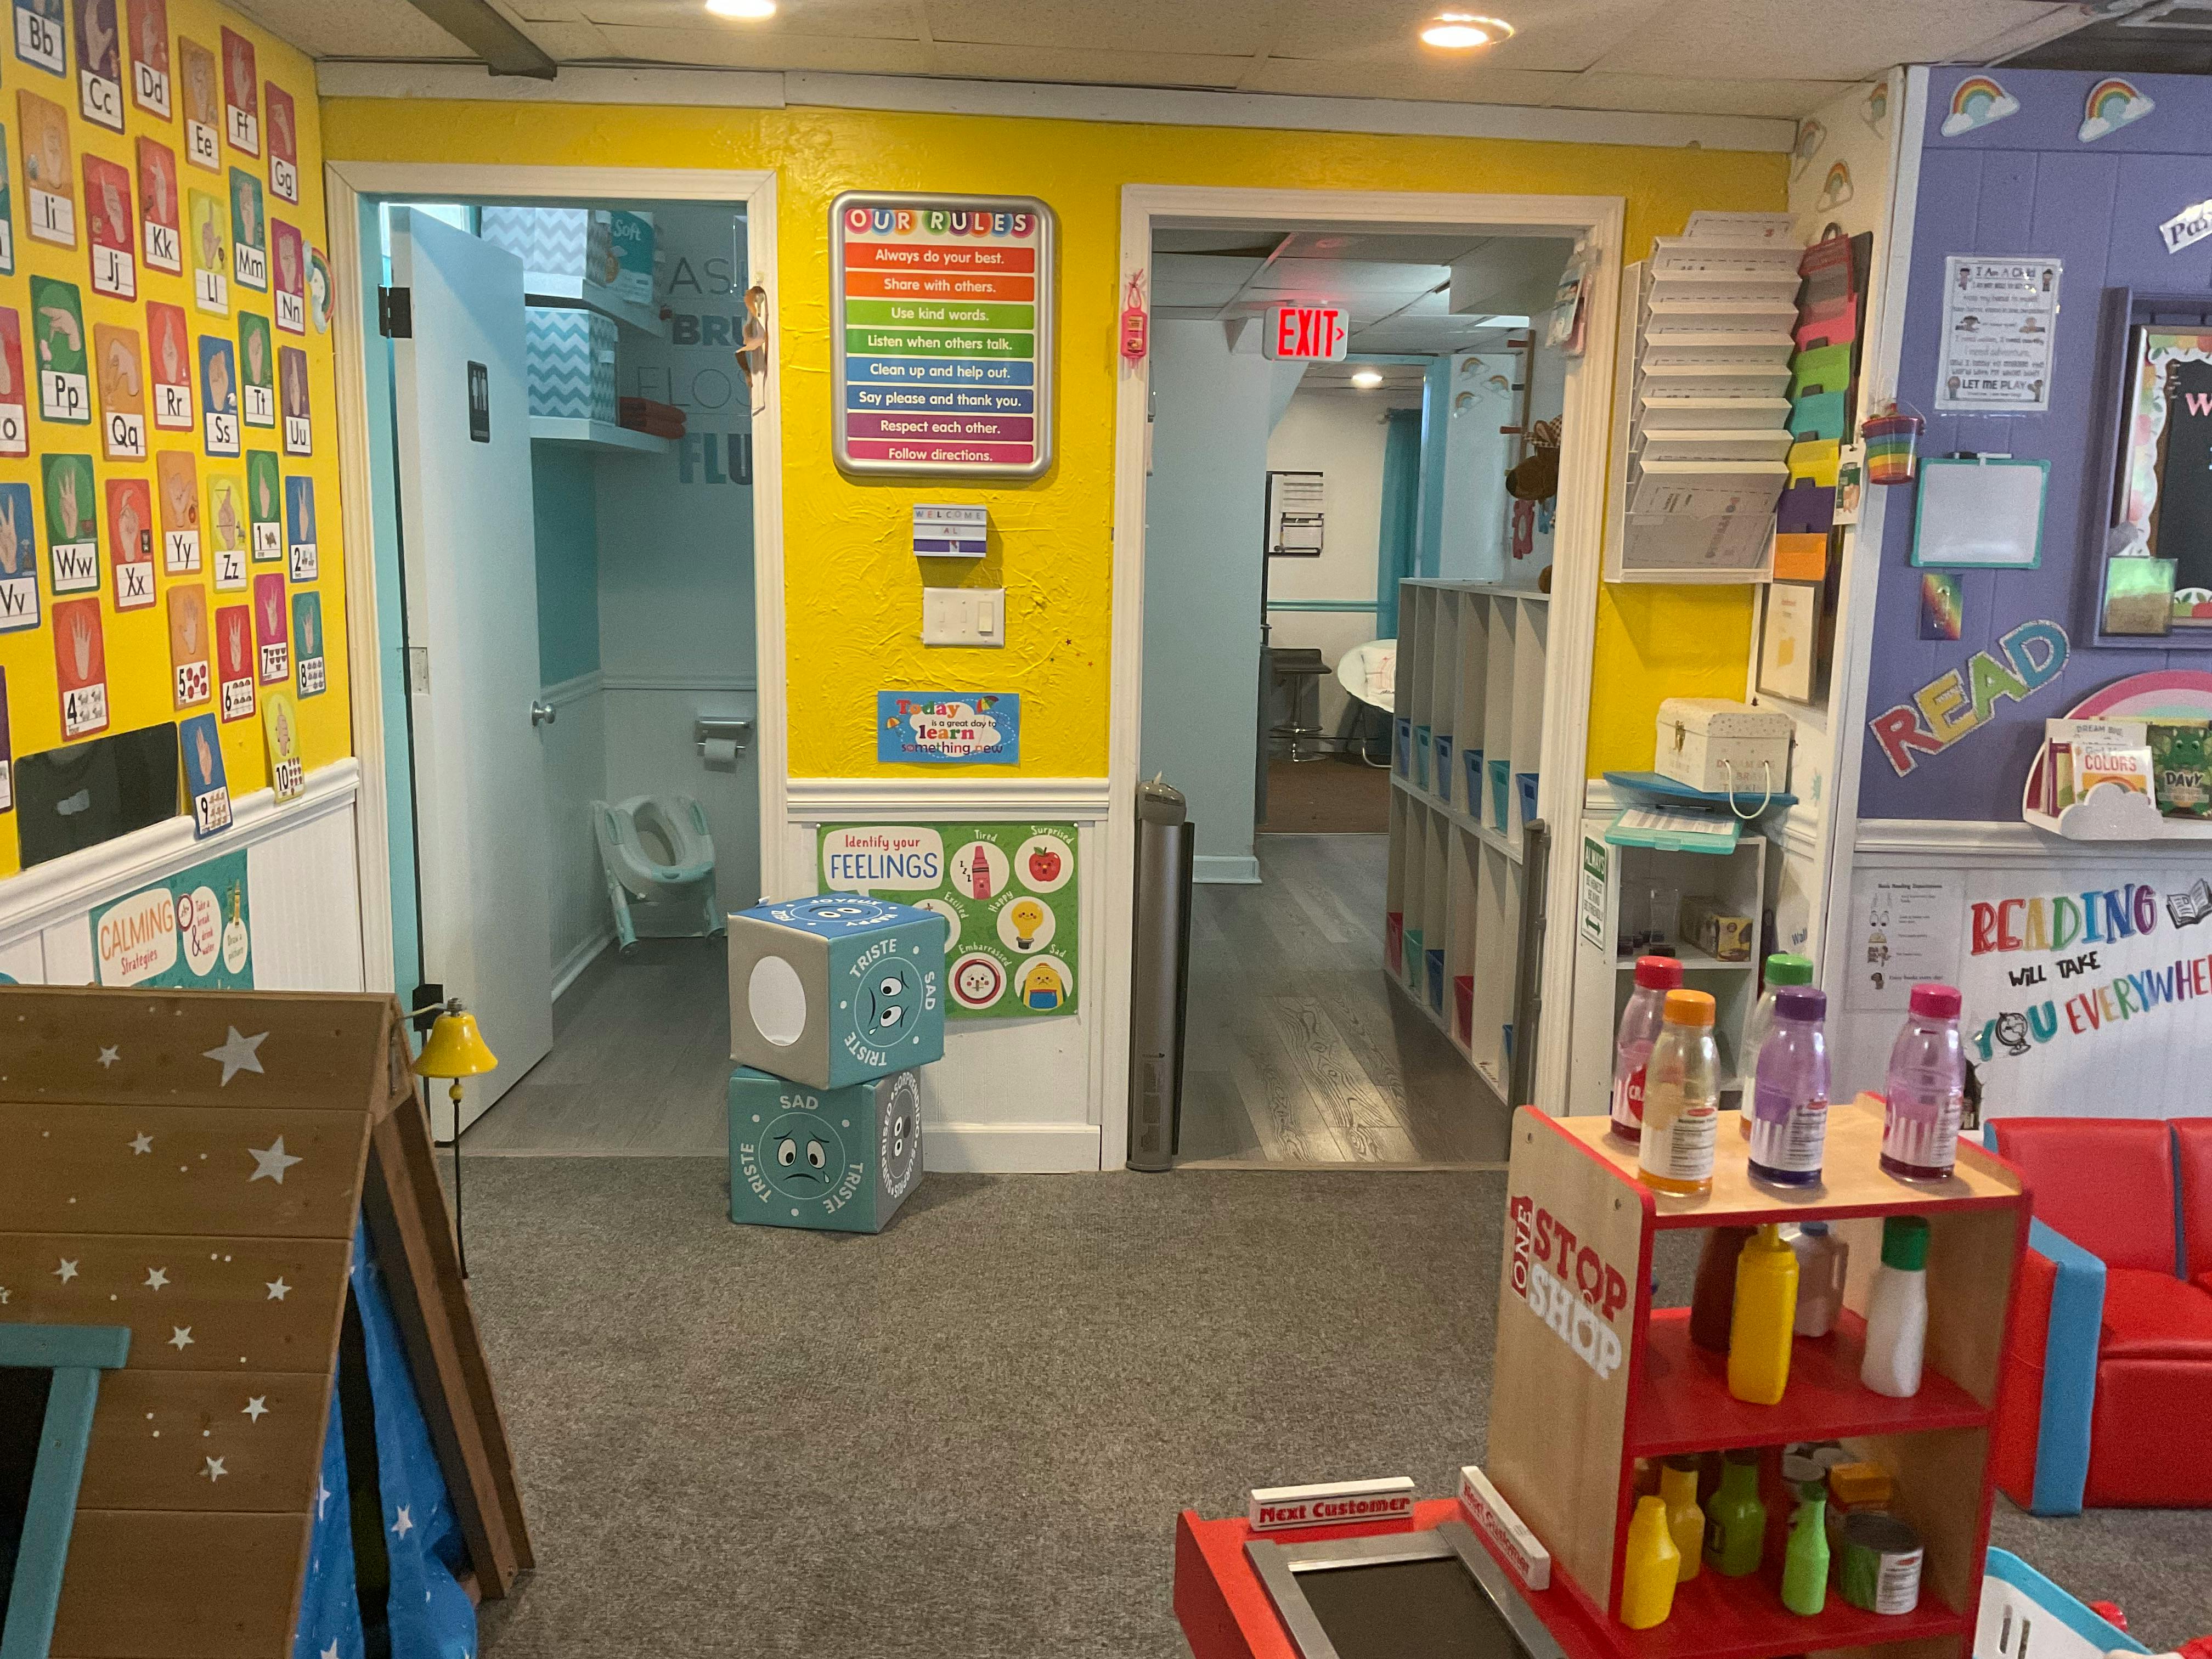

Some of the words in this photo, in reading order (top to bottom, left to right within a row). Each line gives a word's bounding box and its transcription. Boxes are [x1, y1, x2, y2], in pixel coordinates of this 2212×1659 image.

[30, 16, 53, 56] Bb
[89, 78, 112, 115] Cc
[142, 72, 163, 104] Dd
[236, 111, 249, 138] Ff
[196, 127, 212, 156] Ee
[275, 161, 292, 196] Gg
[45, 196, 55, 229] Ii
[851, 210, 910, 230] OUR
[931, 212, 1026, 232] RULES
[153, 227, 172, 259] Kk
[108, 251, 119, 290] Jj
[239, 250, 262, 276] Mm
[876, 249, 919, 264] Always
[924, 251, 939, 262] do
[944, 253, 970, 265] your
[974, 251, 1004, 264] best.
[207, 274, 218, 303] Ll
[884, 278, 919, 290] Share
[924, 280, 950, 291] with
[955, 281, 996, 292] others.
[283, 295, 300, 322] Nn
[891, 307, 914, 319] Use
[919, 308, 944, 320] kind
[949, 309, 989, 321] words.
[868, 335, 902, 347] Listen
[907, 336, 940, 348] when
[945, 337, 982, 349] others
[987, 338, 1012, 350] talk.
[1278, 309, 1338, 357] EXIT
[870, 364, 905, 375] Clean
[909, 367, 925, 379] up
[930, 365, 952, 377] and
[957, 366, 983, 380] help
[988, 368, 1010, 379] out.
[1963, 380, 1979, 389] LET
[2001, 381, 2026, 390] PLAY
[55, 376, 78, 416] Pp
[167, 388, 182, 416] Rr
[254, 389, 266, 414] Tt
[859, 392, 881, 405] Say
[886, 392, 925, 405] please
[930, 393, 953, 405] and
[957, 394, 991, 407] thank
[996, 398, 1022, 408] you.
[112, 415, 138, 454] Qq
[215, 417, 230, 443] Ss
[291, 420, 307, 446] Uu
[881, 420, 928, 433] Respect
[932, 421, 961, 433] each
[966, 422, 1001, 434] other.
[889, 448, 927, 460] Follow
[931, 449, 992, 461] directions.
[916, 510, 981, 520] WELCOME
[257, 525, 262, 550] 1
[56, 549, 92, 578] Ww
[173, 534, 191, 569] Yy
[294, 548, 301, 571] 2
[223, 554, 238, 580] Zz
[126, 567, 145, 597] Xx
[0, 584, 24, 615] Vv
[263, 648, 268, 674] 7
[179, 669, 185, 696] 5
[300, 663, 307, 687] 8
[67, 693, 77, 724] 4
[224, 688, 232, 712] 6
[896, 698, 961, 719] Today
[1869, 619, 2070, 777] READ
[919, 725, 974, 740] learn
[947, 720, 968, 729] great
[970, 719, 986, 729] day
[901, 742, 970, 755] something
[975, 744, 1003, 754] new
[2085, 754, 2137, 771] COLORS
[275, 767, 289, 791] 10
[2166, 771, 2203, 787] DAVY
[201, 797, 207, 824] 9
[845, 834, 889, 850] Identify
[893, 838, 921, 851] your
[974, 830, 998, 843] Tired
[1031, 826, 1075, 845] Surprised
[831, 853, 938, 879] FEELINGS
[944, 891, 969, 919] Excited
[988, 890, 1014, 913] Happy
[101, 900, 173, 960] CALMING
[846, 913, 898, 927] HAPPY
[1971, 883, 2157, 955] READING
[121, 950, 157, 975] Strategies
[850, 938, 897, 979] TRISTE
[959, 941, 1012, 967] Embarrassed
[1049, 944, 1066, 958] Sad
[2056, 951, 2101, 978] TAKE
[924, 970, 935, 1010] SAD
[2066, 954, 2212, 1034] EVERYWHE
[844, 1032, 887, 1066] TRISTE
[780, 1096, 819, 1110] SAD
[894, 1071, 920, 1138] SORPRENDIDO
[882, 1102, 892, 1193] SURPRISED
[741, 1143, 771, 1203] TRISTE
[894, 1148, 916, 1198] SURPRIS
[824, 1162, 864, 1215] TRISTE
[1514, 1205, 1533, 1289] ONE
[1534, 1209, 1627, 1322] STOP
[1530, 1263, 1622, 1379] SHOP
[1259, 1506, 1306, 1523] Next
[1313, 1496, 1410, 1518] Customer
